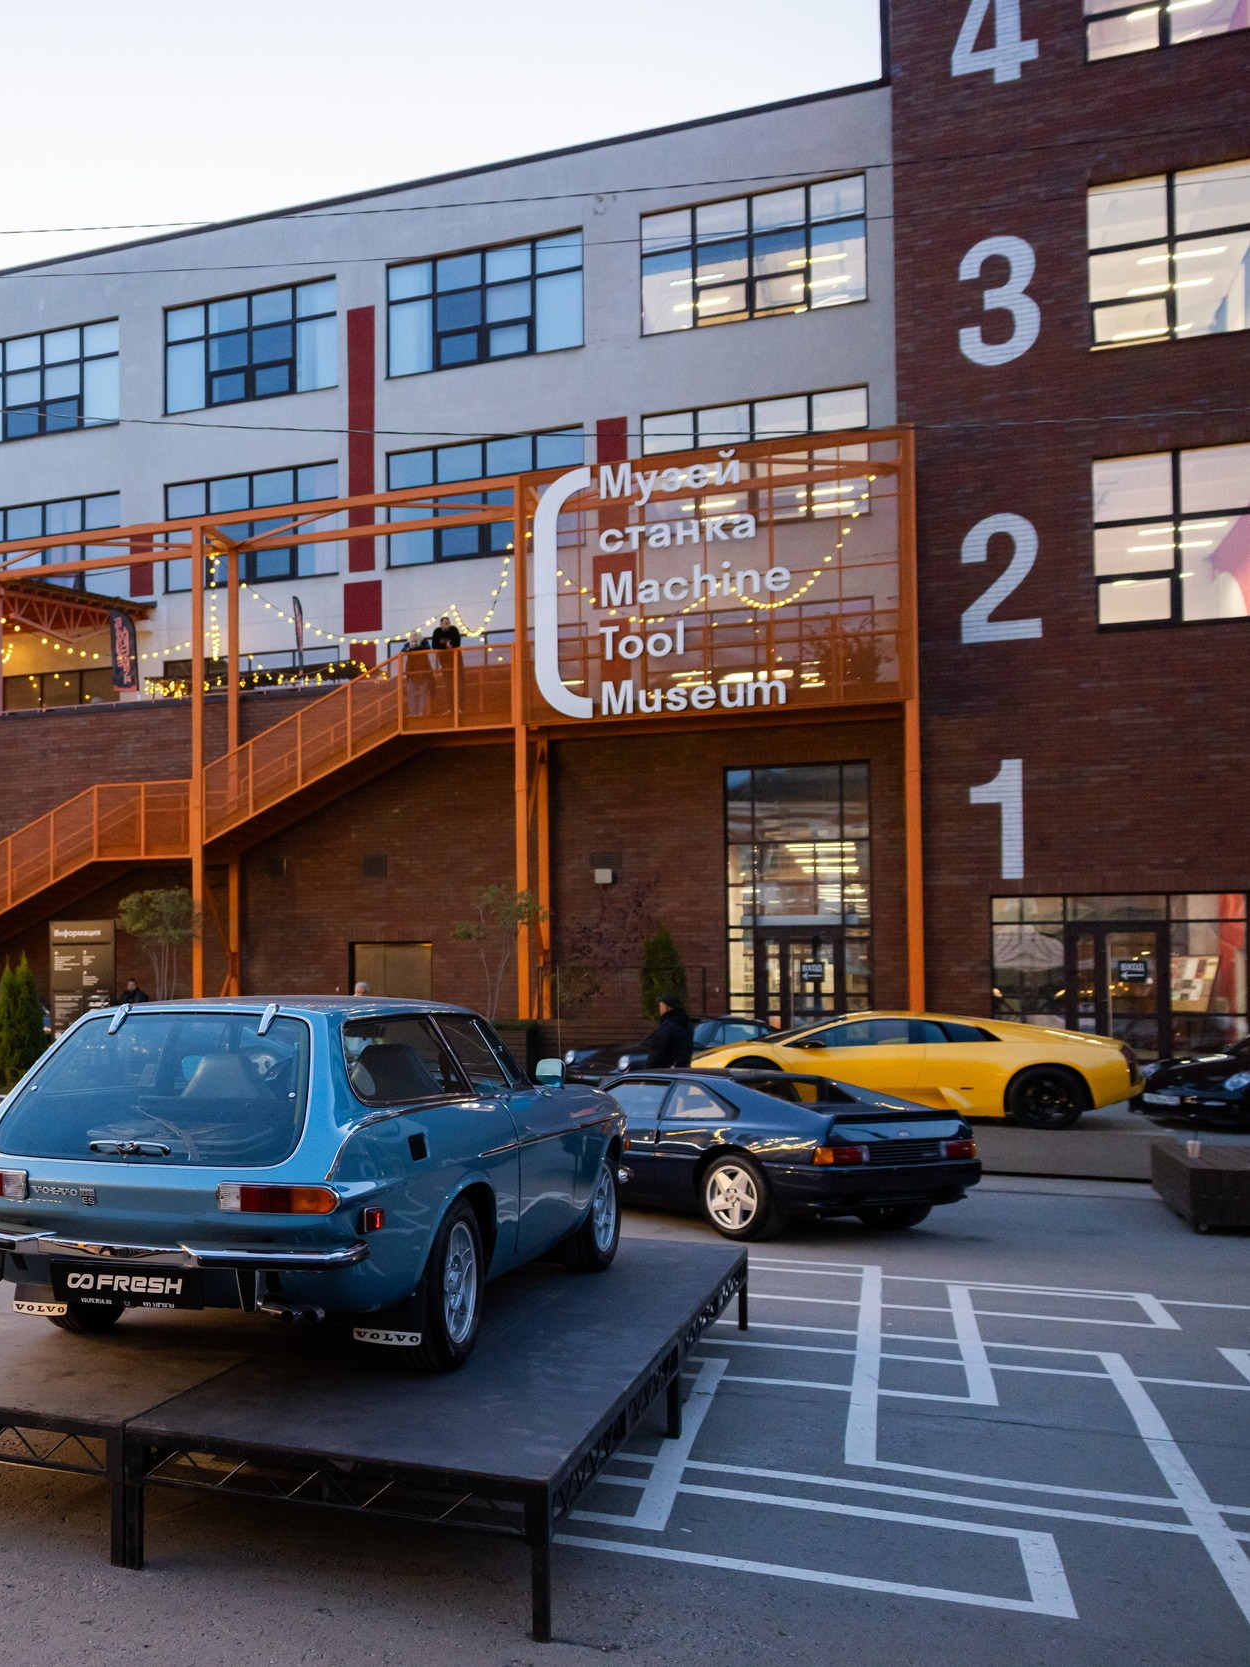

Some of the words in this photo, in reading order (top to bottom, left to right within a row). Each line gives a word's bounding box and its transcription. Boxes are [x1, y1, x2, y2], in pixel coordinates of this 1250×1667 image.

[951, 0, 1039, 84] 4
[958, 236, 1042, 366] 3
[601, 449, 740, 506] Музей
[600, 513, 757, 553] станка
[601, 561, 792, 608] Machine
[961, 513, 1043, 644] 2
[601, 620, 685, 661] Tool
[601, 680, 787, 716] Museum
[969, 759, 1025, 880] 1
[31, 1185, 78, 1197] VOLVO
[15, 1304, 65, 1314] VOLVO
[355, 1330, 419, 1343] VOLVO
